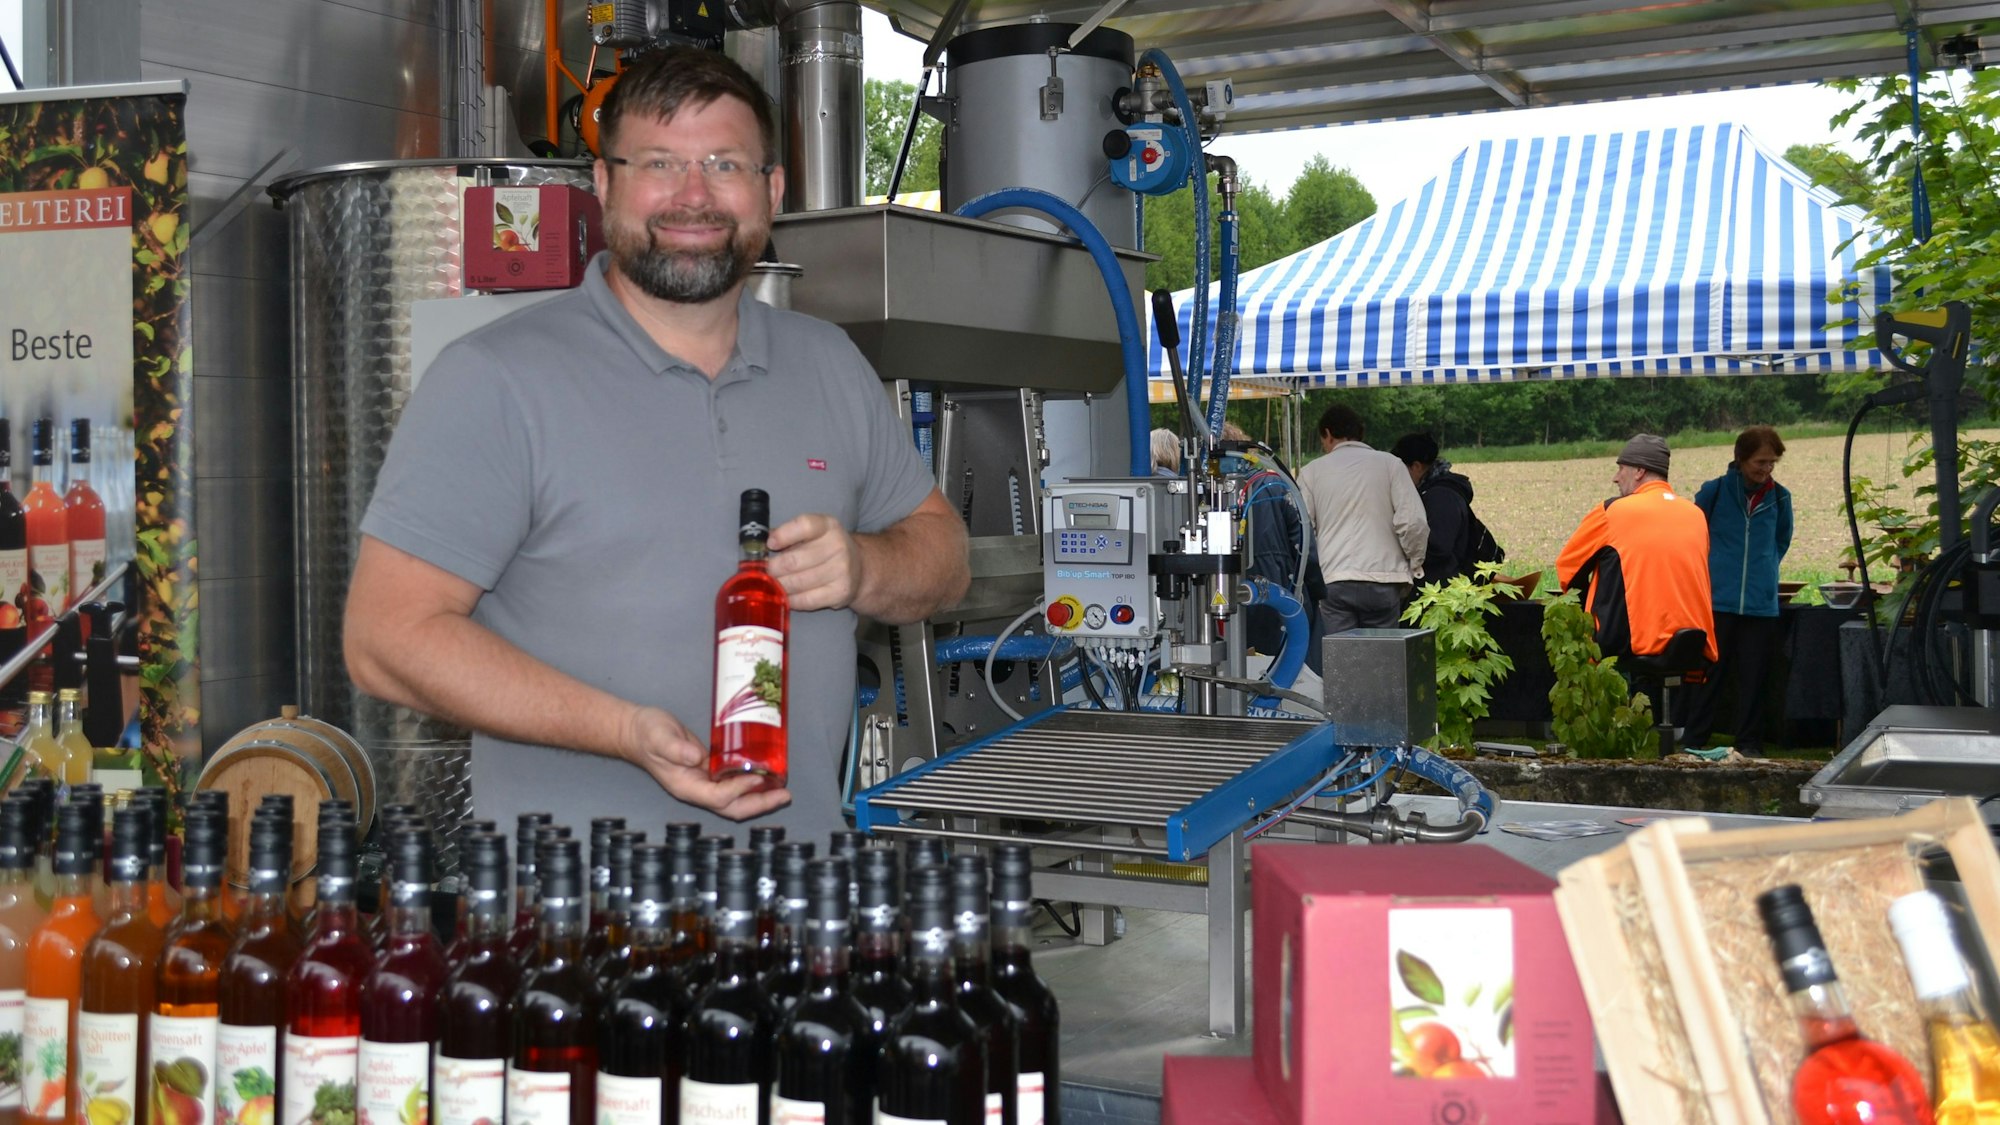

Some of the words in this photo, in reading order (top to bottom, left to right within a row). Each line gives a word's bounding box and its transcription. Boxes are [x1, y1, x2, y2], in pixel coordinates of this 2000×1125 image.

[0, 196, 126, 227] ELTEREI
[478, 275, 497, 283] Liter
[12, 328, 92, 361] Beste
[1084, 570, 1110, 578] Smart
